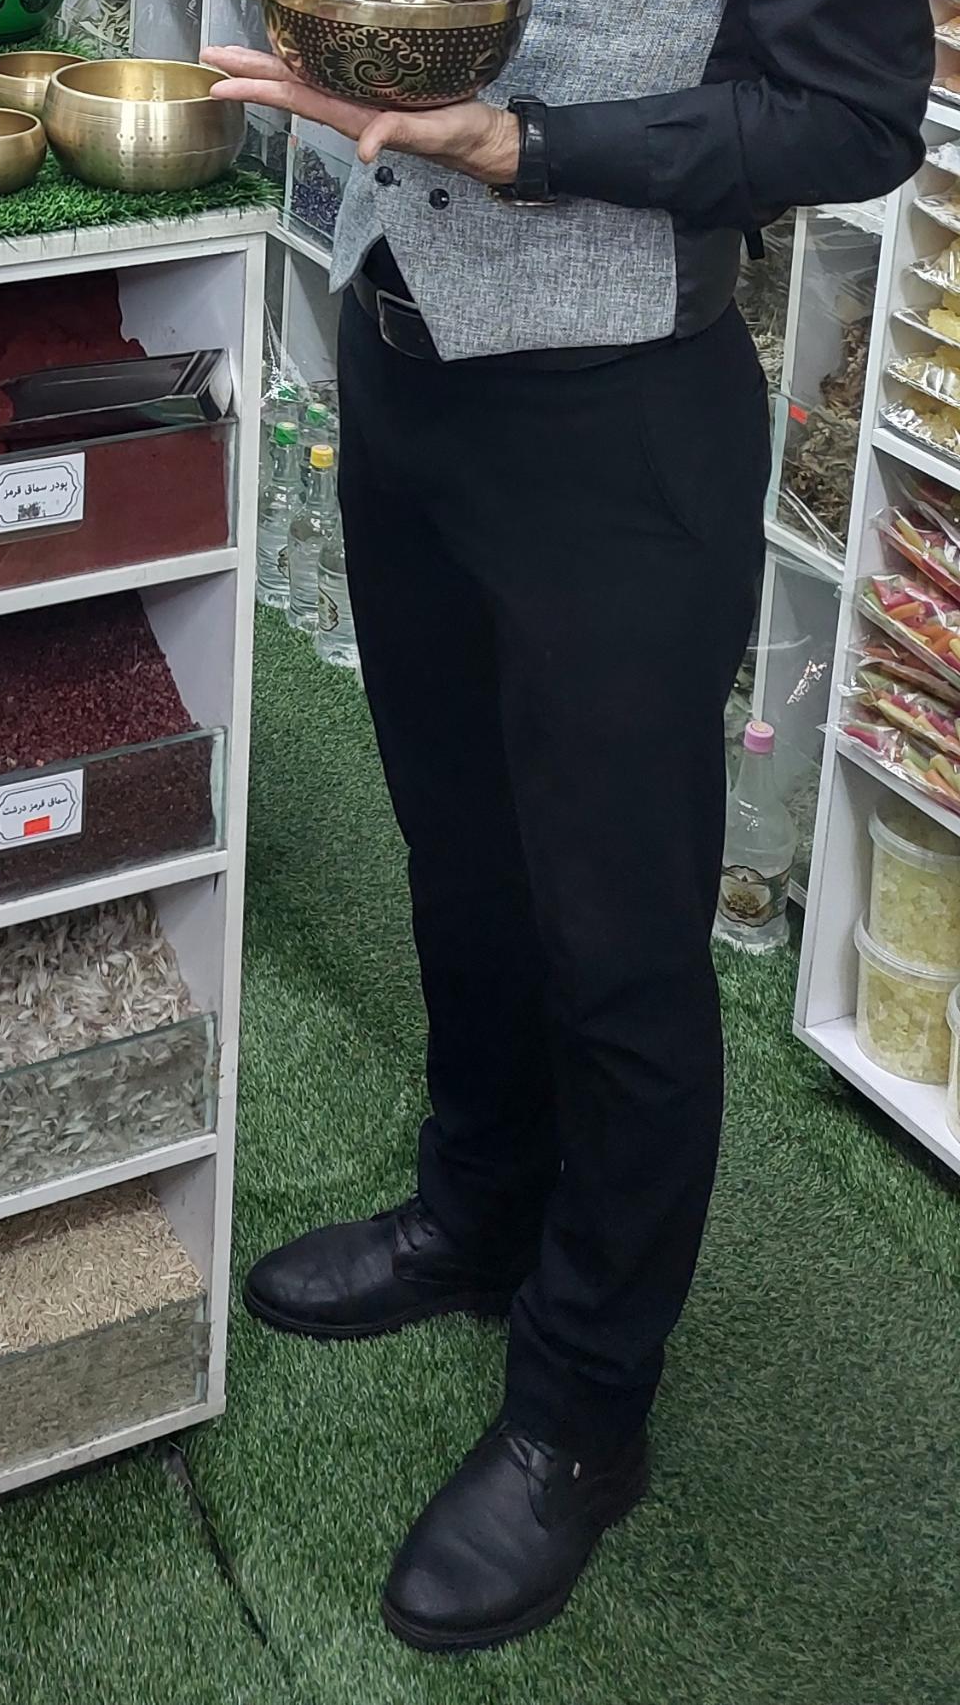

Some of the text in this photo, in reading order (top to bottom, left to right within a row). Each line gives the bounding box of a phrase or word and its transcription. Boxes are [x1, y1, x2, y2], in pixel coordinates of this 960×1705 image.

[3, 480, 68, 499] پودر سماق قرمز
[2, 796, 68, 816] سماق قرمز درشت
